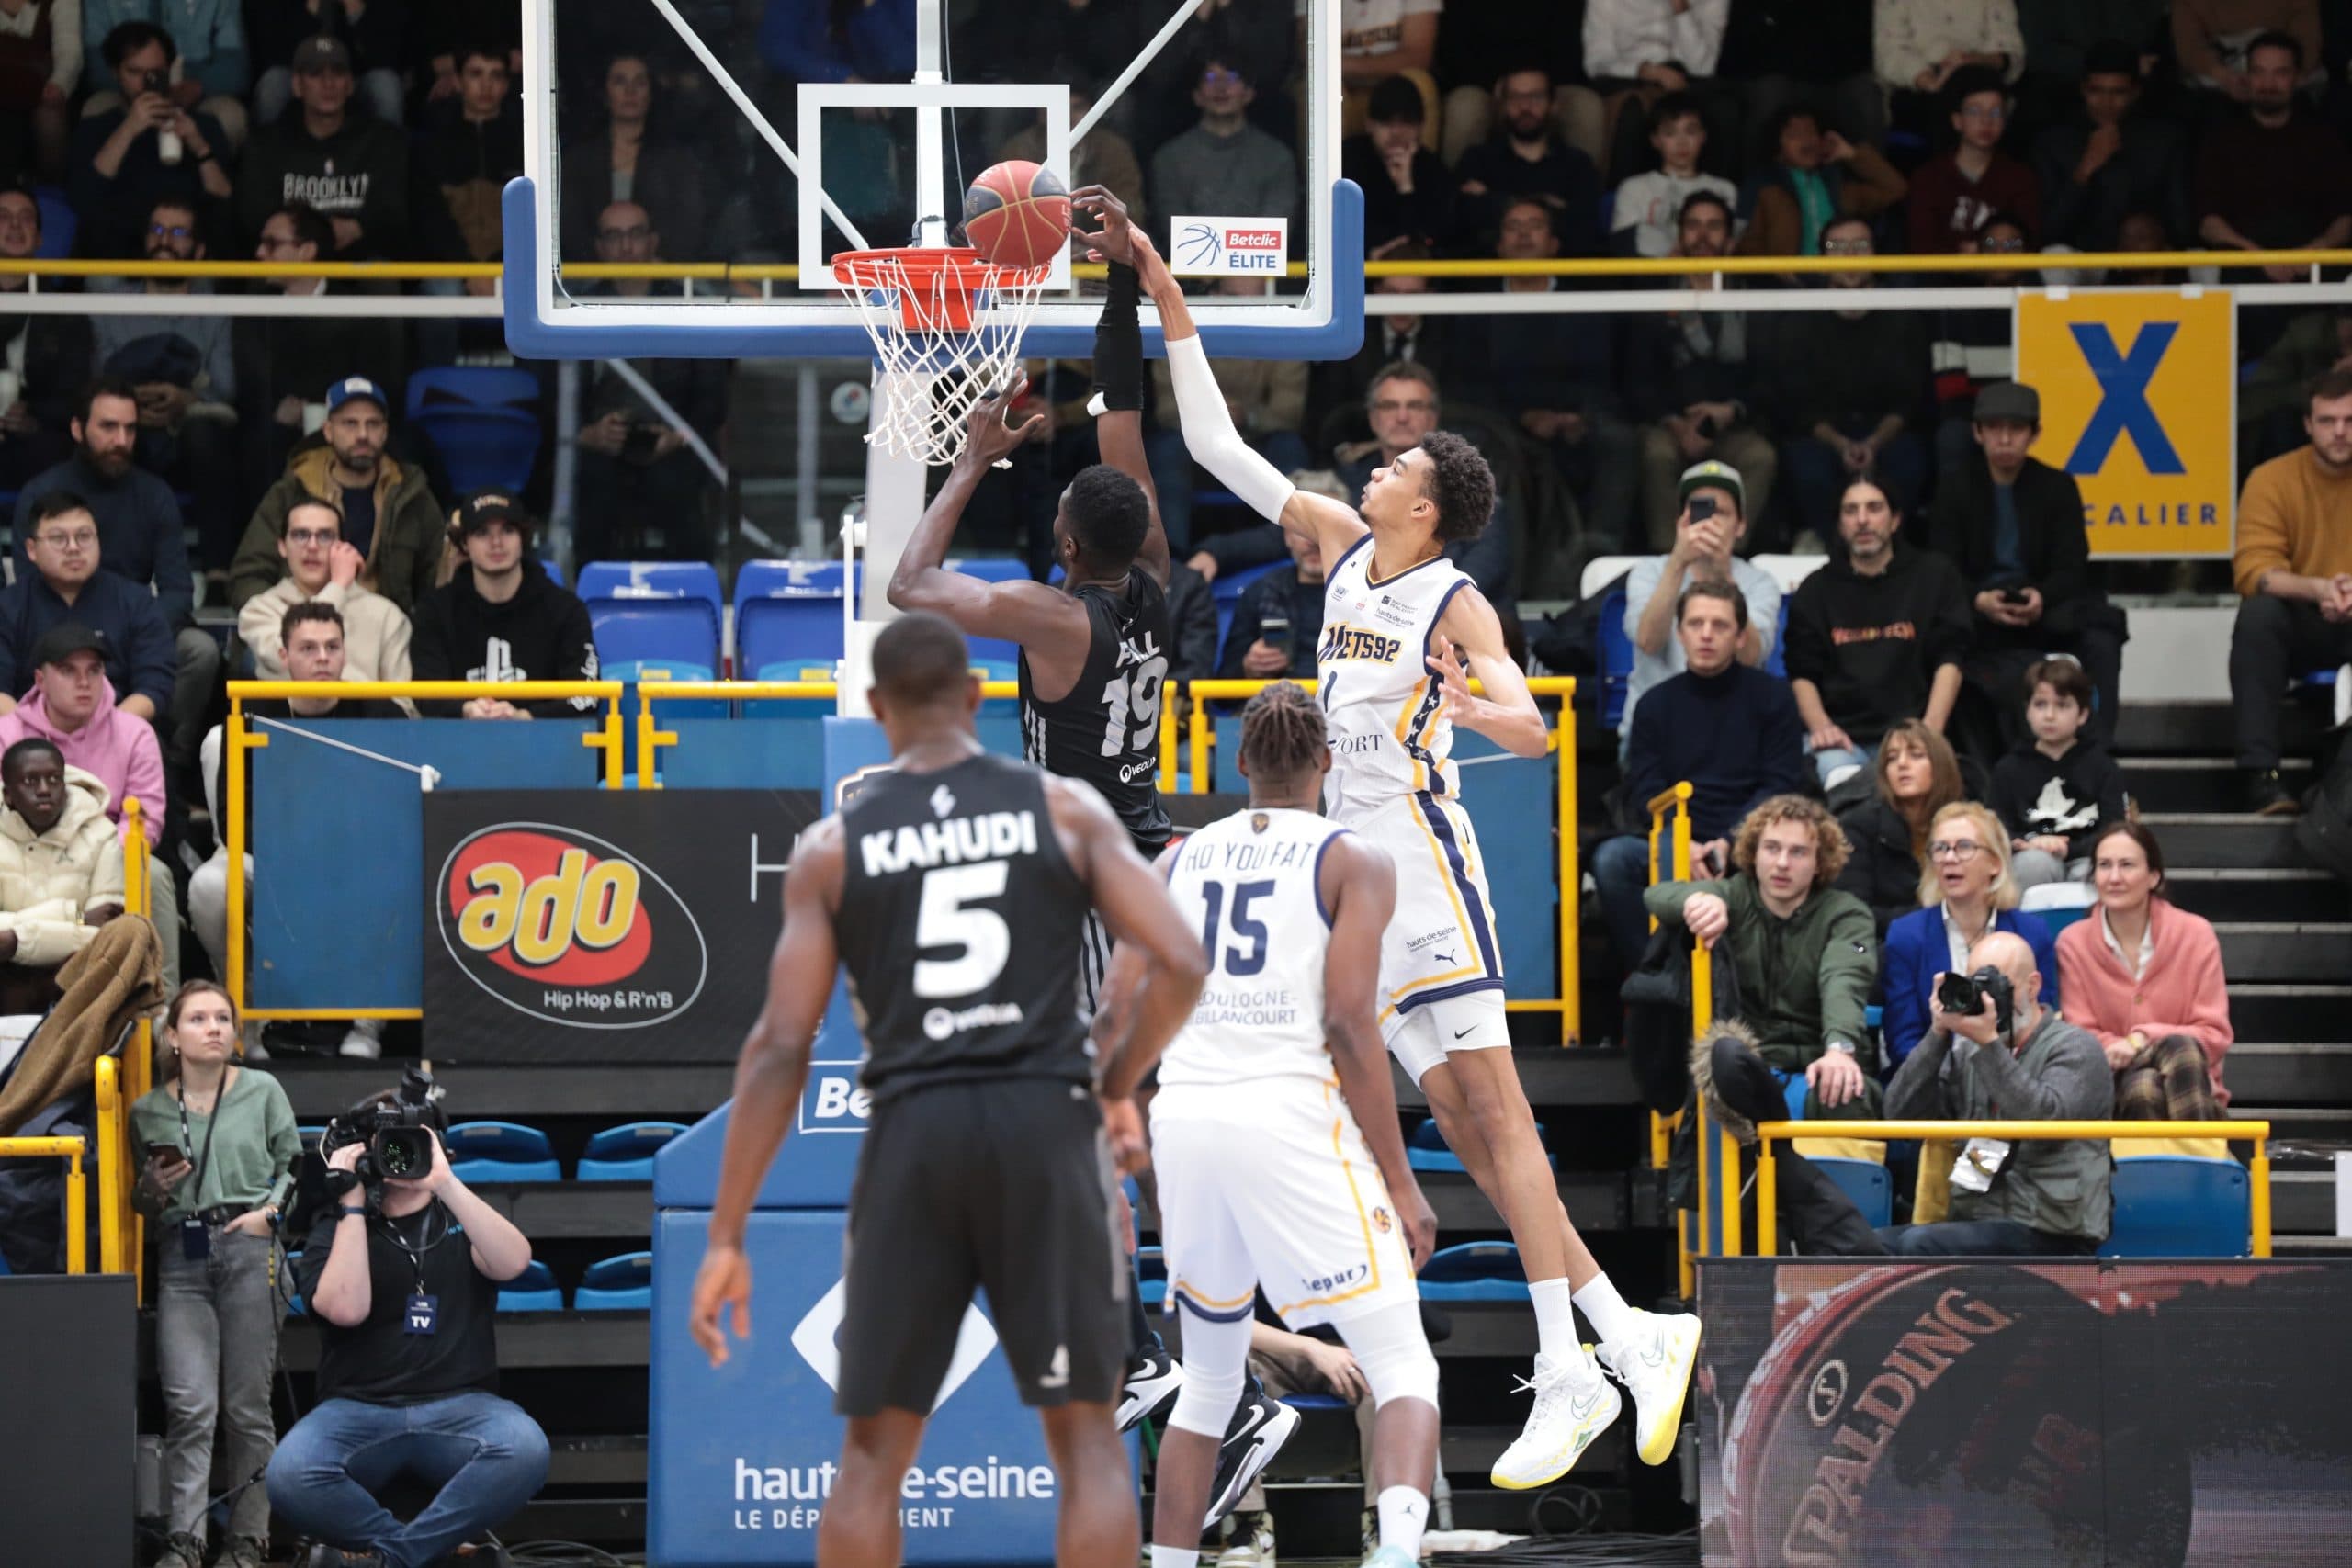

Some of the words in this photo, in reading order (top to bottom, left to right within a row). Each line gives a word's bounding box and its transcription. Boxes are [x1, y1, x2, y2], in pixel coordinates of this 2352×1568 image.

[1229, 232, 1277, 247] Betclic
[1229, 251, 1276, 268] ÉLITE
[2064, 322, 2188, 476] X
[2084, 502, 2218, 526] CALIER
[1317, 624, 1402, 664] METS92
[1102, 655, 1169, 757] 19
[1330, 734, 1383, 755] ORT
[861, 810, 1038, 877] KAHUDI
[1185, 844, 1215, 873] HO
[458, 848, 641, 964] ado
[913, 859, 1011, 998] 5
[1201, 879, 1276, 976] 15
[544, 990, 573, 1011] Hip
[575, 990, 612, 1012] Hop
[614, 991, 627, 1009] &
[628, 991, 673, 1009] R'n'B
[411, 1315, 431, 1328] TV
[735, 1455, 1055, 1500] haute-seine
[735, 1509, 762, 1529] LE
